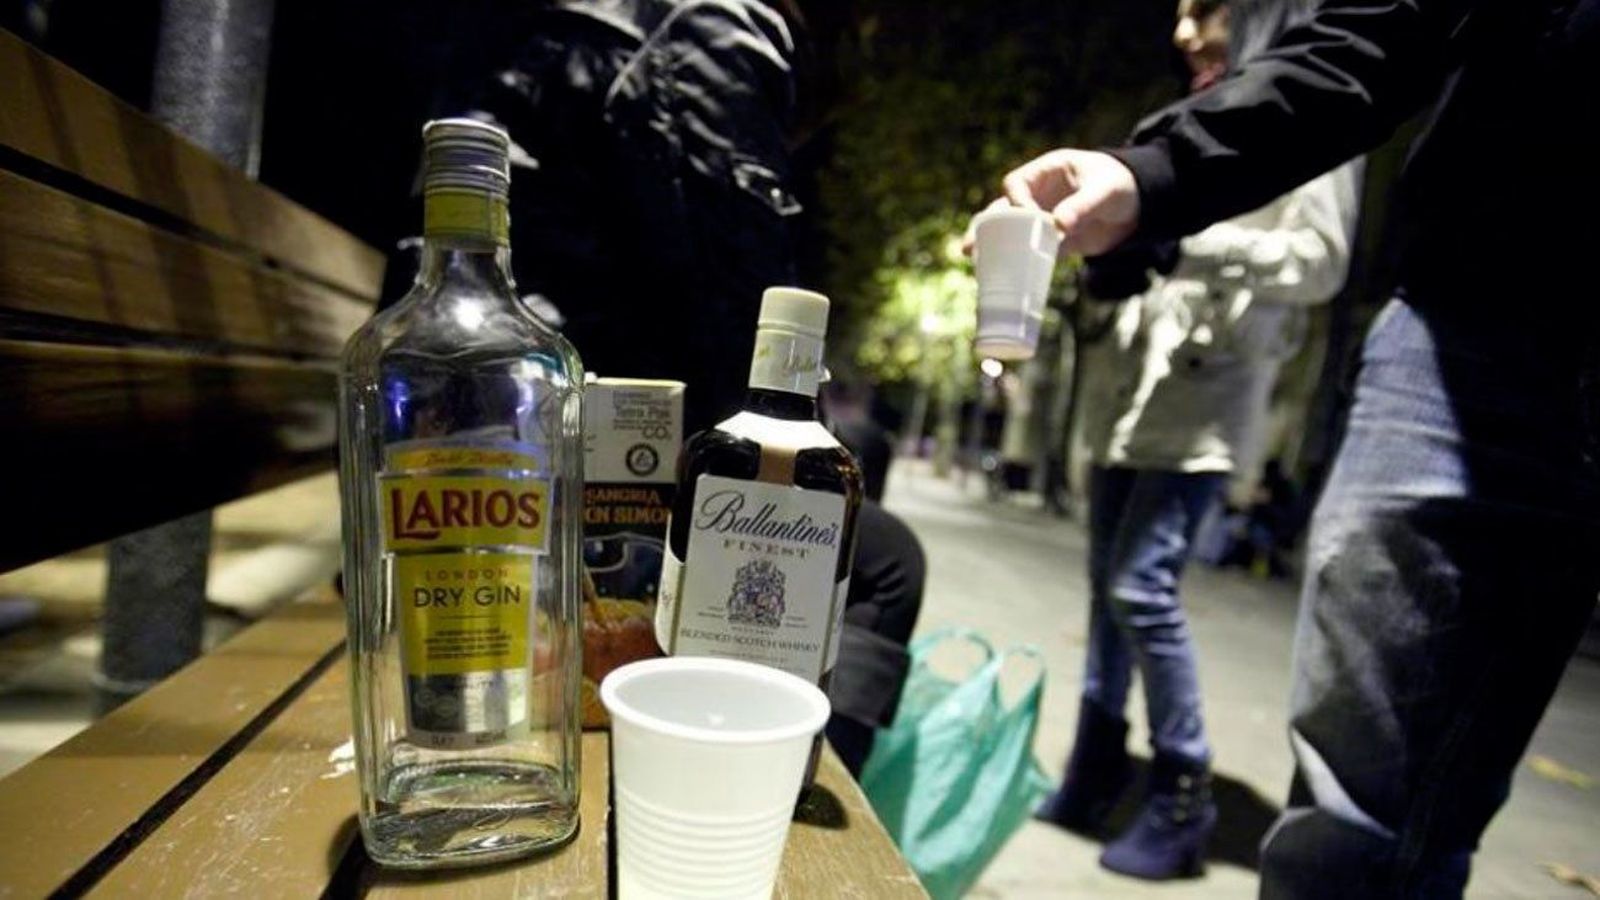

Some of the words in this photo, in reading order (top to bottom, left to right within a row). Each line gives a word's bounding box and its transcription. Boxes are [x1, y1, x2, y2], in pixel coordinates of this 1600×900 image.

[584, 487, 661, 504] SANGRIA
[390, 488, 541, 540] LARIOS
[585, 506, 610, 524] ON
[694, 490, 839, 548] Ballantine's
[723, 538, 810, 559] FINEST
[425, 567, 509, 581] LONDON
[413, 587, 464, 608] DRY
[474, 584, 521, 607] GIN
[680, 627, 730, 644] BLENDED
[732, 634, 777, 649] SCOTCH
[779, 639, 822, 653] WHISKY
